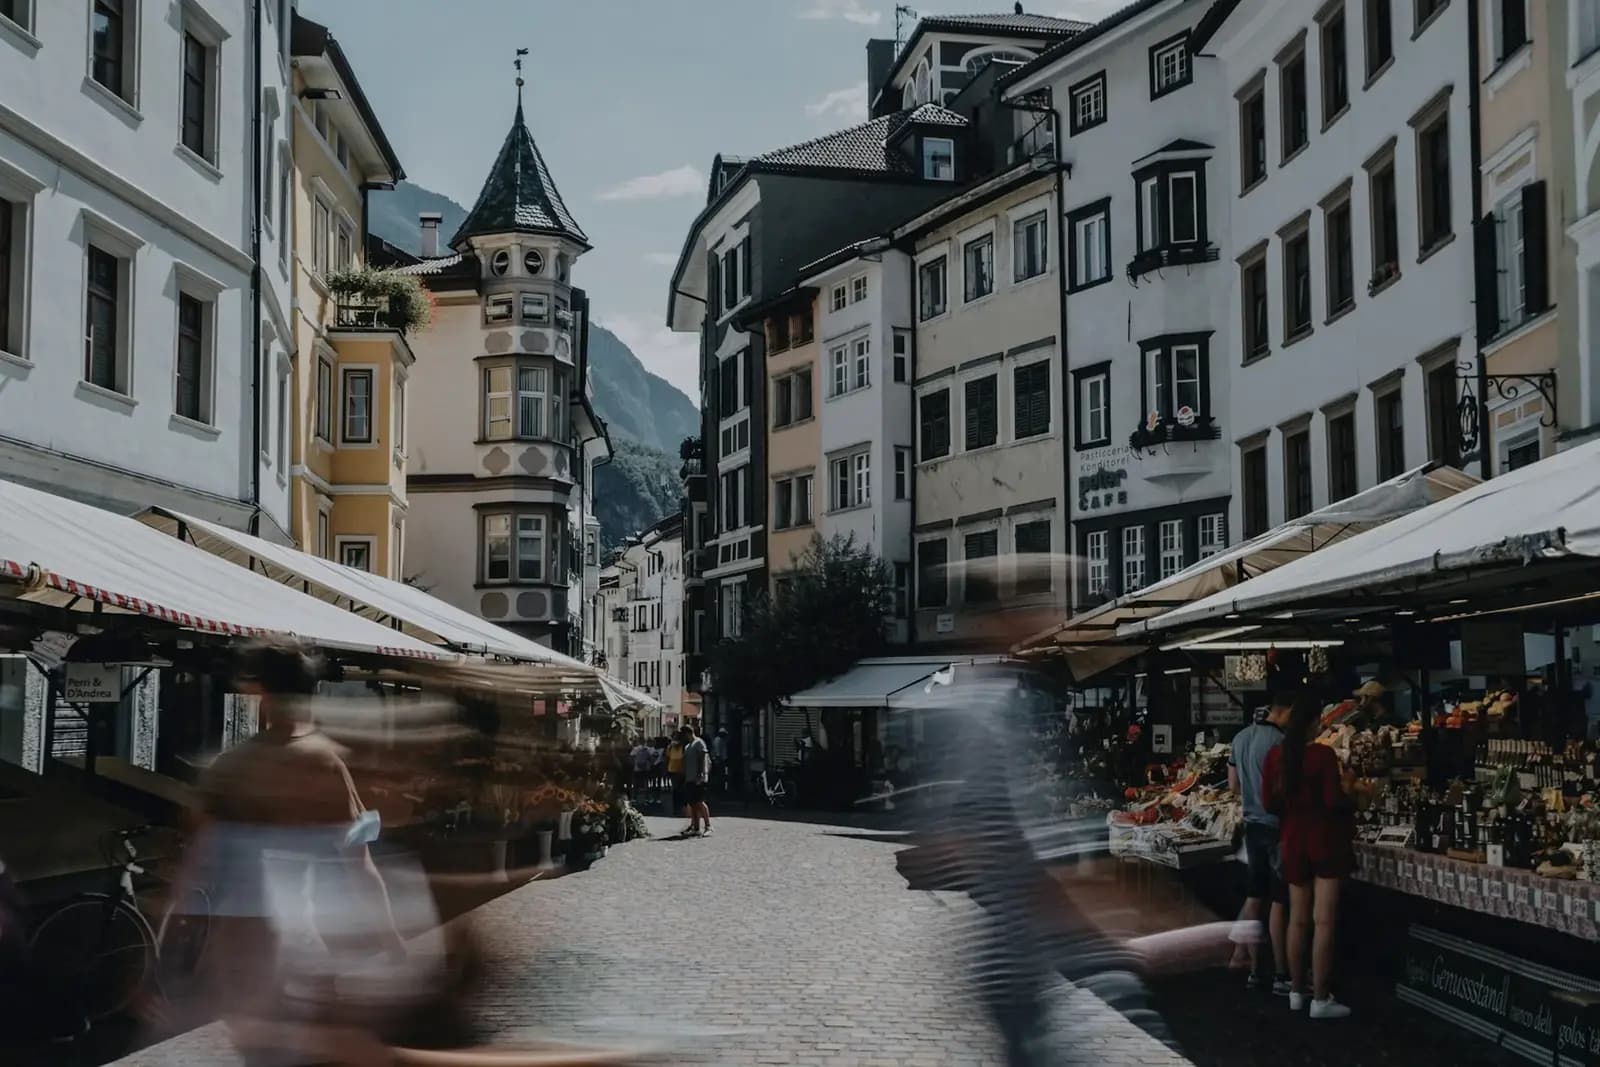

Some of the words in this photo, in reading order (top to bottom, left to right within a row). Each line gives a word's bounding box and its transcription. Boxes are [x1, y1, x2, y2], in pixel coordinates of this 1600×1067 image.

[1080, 446, 1129, 461] Pasticceria
[1080, 457, 1130, 472] Konditorei
[92, 677, 102, 688] &
